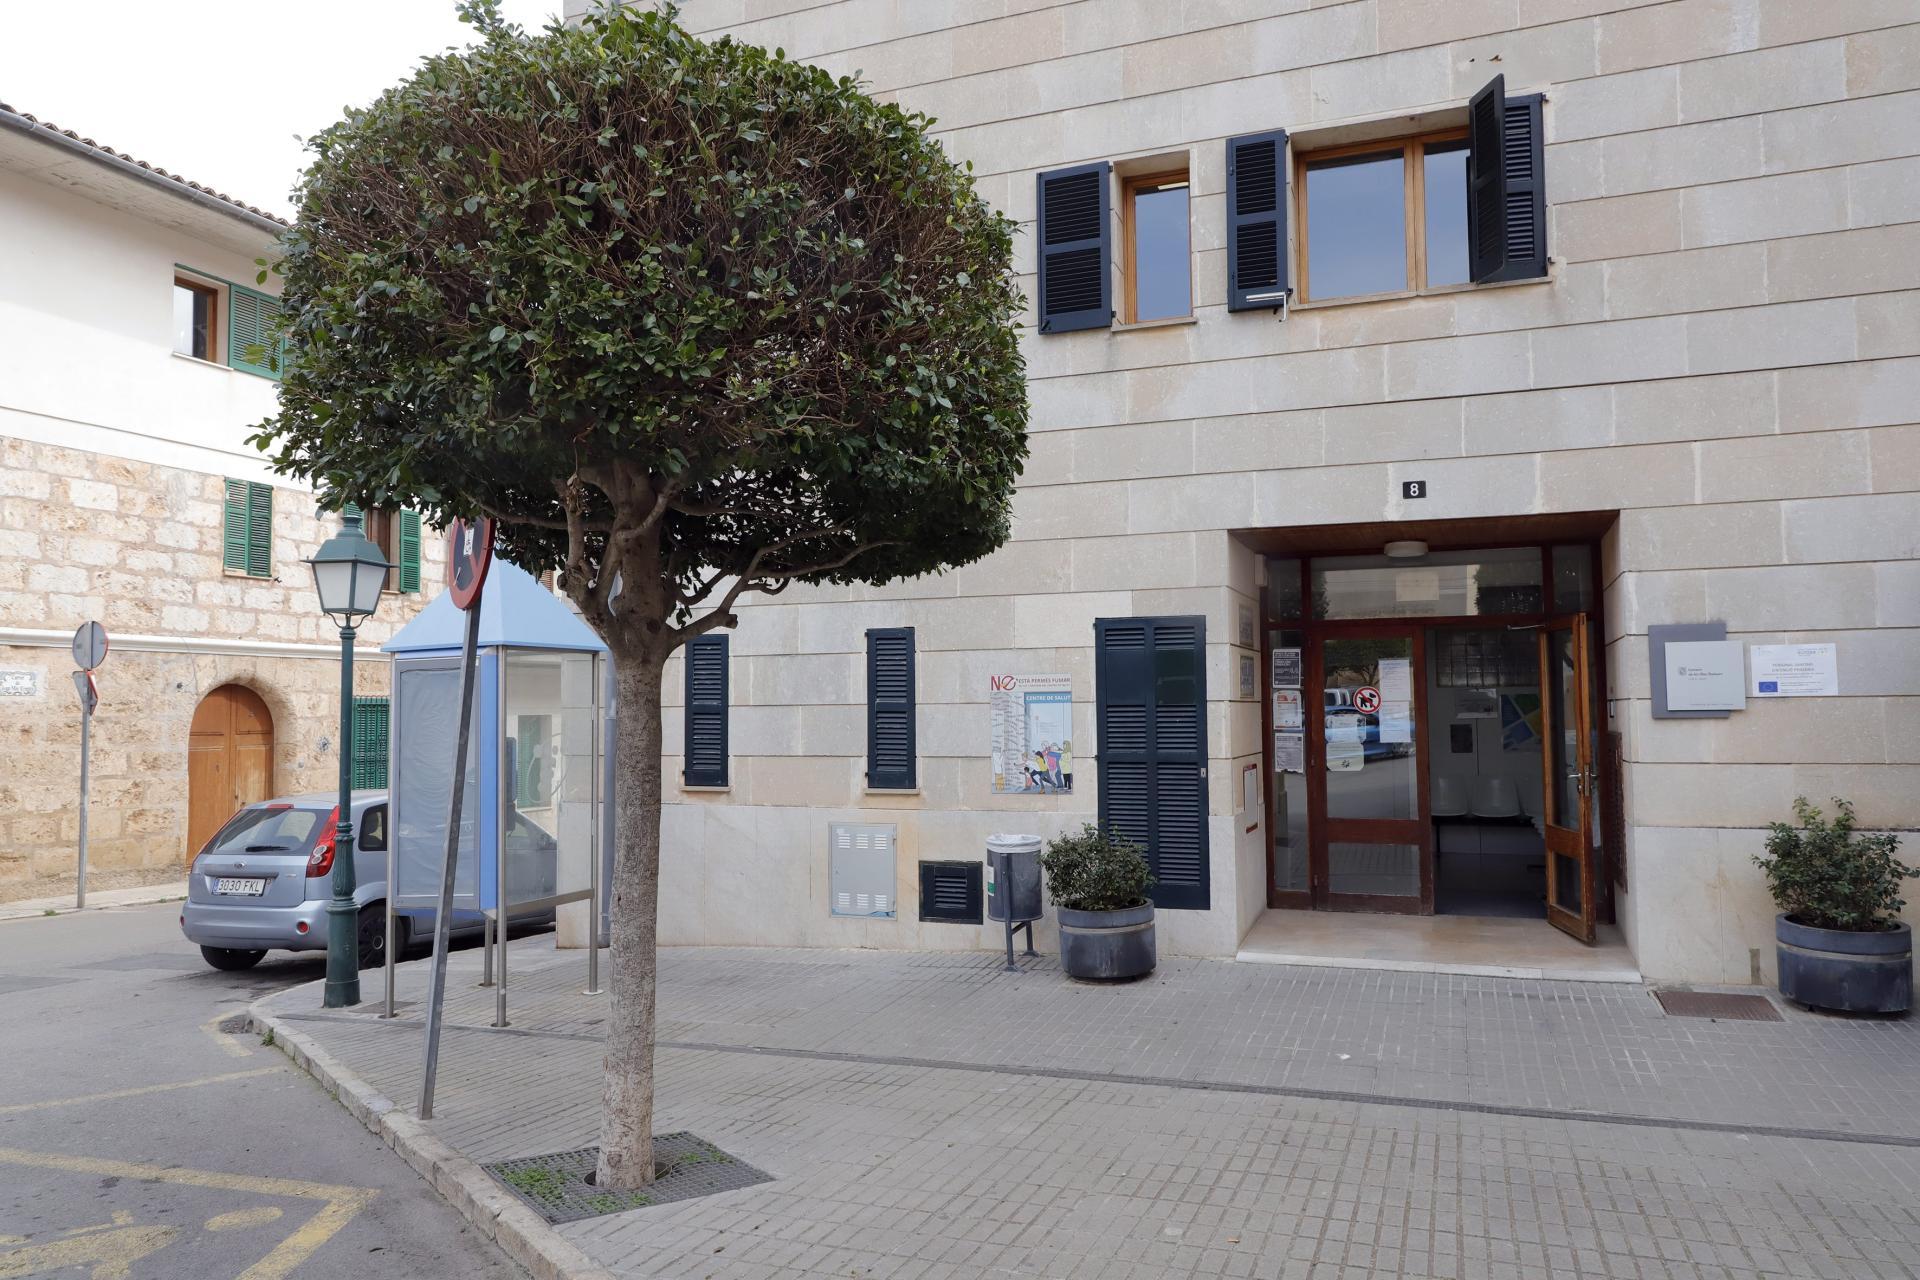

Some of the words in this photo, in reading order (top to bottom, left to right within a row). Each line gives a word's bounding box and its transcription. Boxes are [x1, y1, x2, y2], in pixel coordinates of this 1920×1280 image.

[1410, 483, 1419, 496] 8
[218, 880, 241, 891] 3030
[243, 880, 260, 892] FKL
